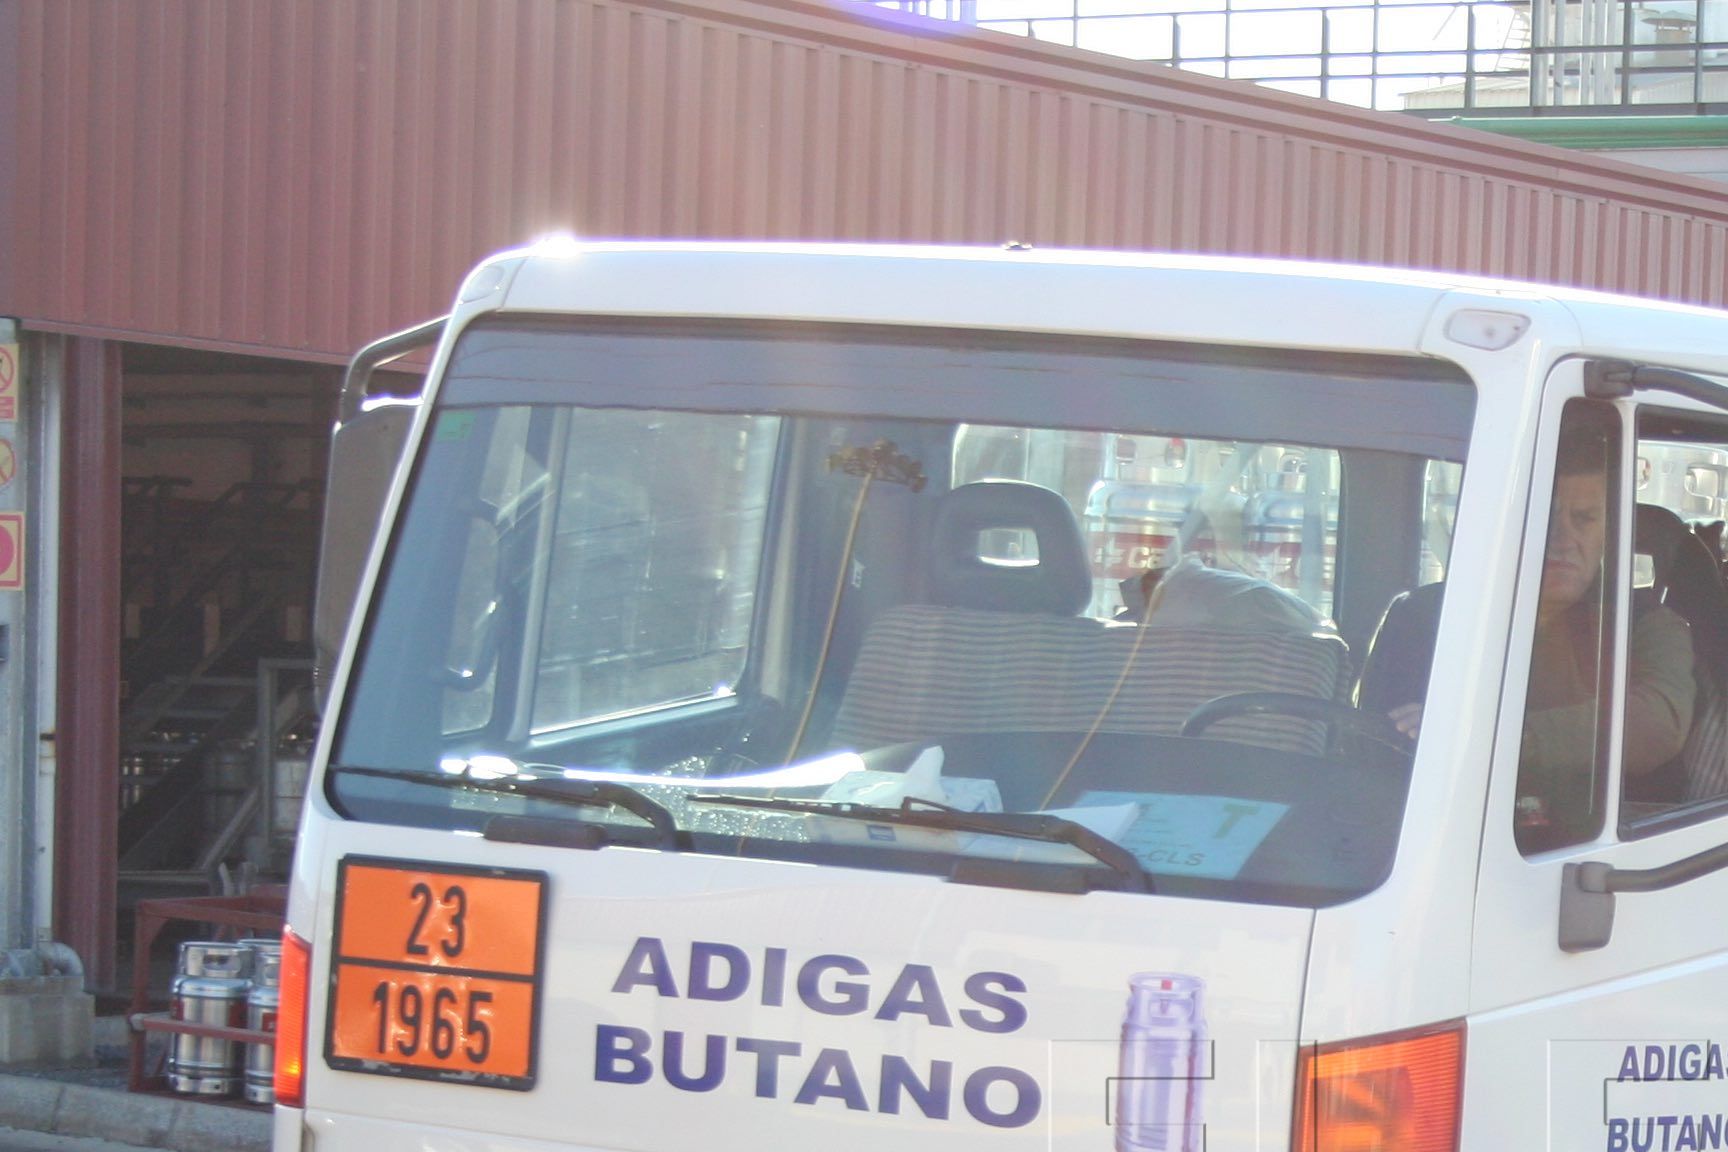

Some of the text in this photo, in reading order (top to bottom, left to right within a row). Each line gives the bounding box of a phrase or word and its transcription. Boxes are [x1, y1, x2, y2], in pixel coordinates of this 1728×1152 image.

[406, 882, 467, 957] 23
[374, 981, 493, 1063] 1965
[611, 936, 1028, 1034] ADIGAS
[594, 1023, 1042, 1128] BUTANO
